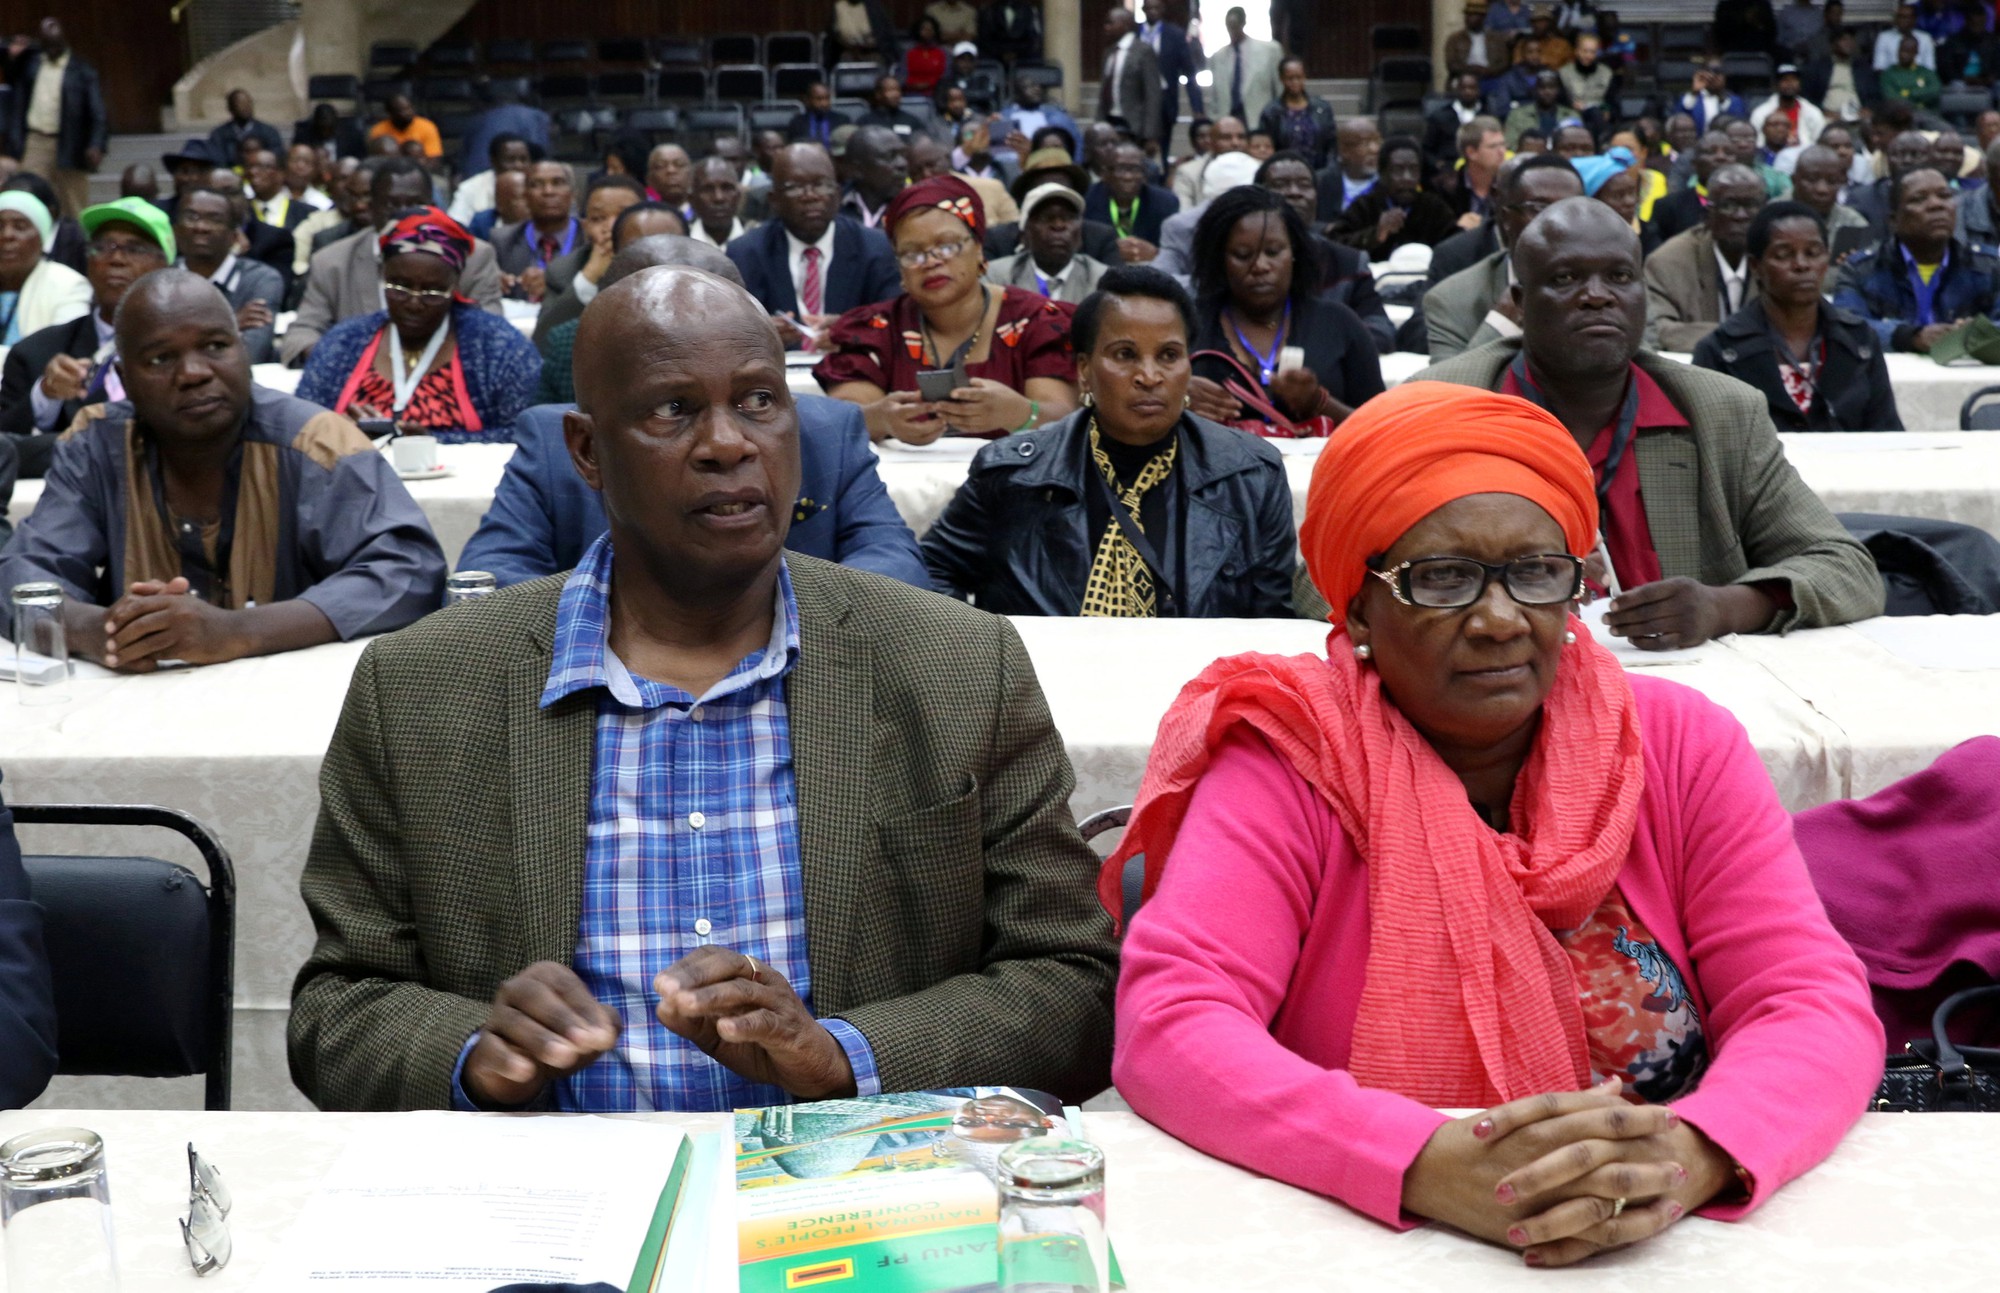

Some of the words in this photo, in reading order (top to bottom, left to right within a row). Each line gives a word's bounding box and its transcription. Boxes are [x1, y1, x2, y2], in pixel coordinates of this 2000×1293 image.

[786, 1201, 940, 1231] CONFERENCE
[865, 1208, 981, 1232] NATIONAL
[755, 1223, 856, 1249] PEOPLE'S
[875, 1252, 909, 1268] PF
